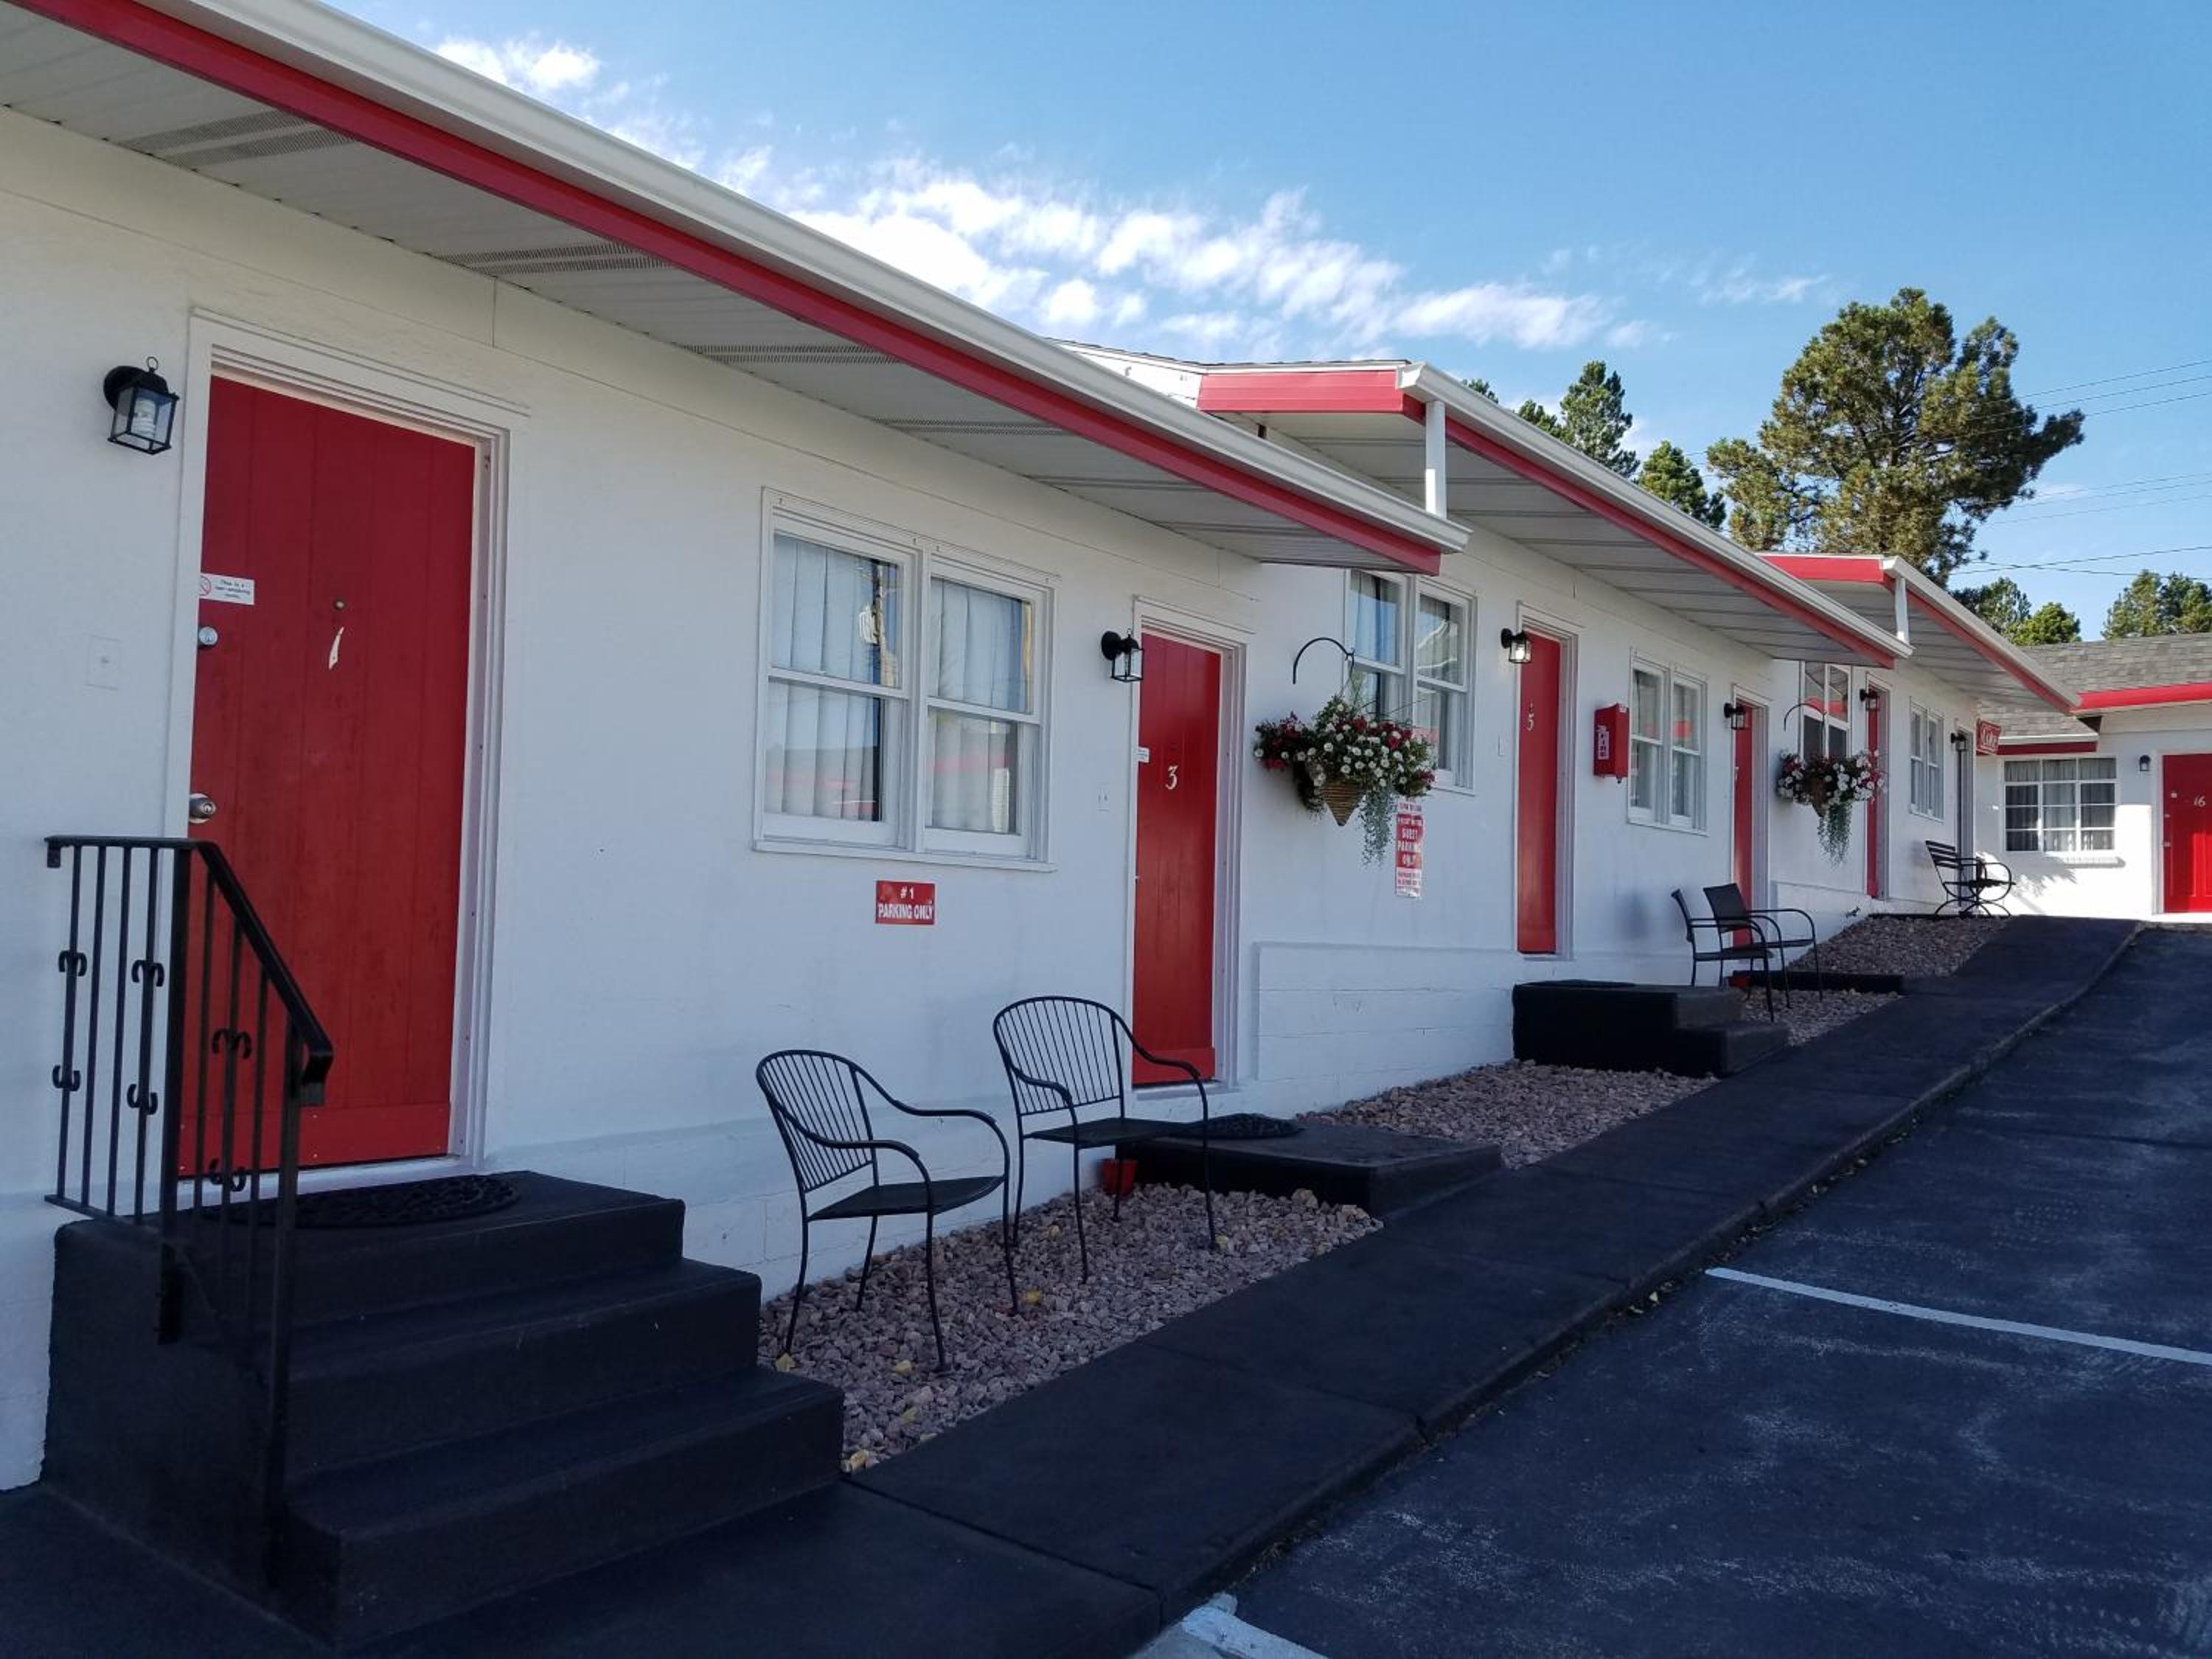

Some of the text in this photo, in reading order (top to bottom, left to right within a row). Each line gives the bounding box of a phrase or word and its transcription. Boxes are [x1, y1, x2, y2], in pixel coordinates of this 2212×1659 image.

[1165, 765, 1178, 790] 3
[2194, 796, 2206, 807] 16
[877, 903, 933, 920] PARKING ONLY
